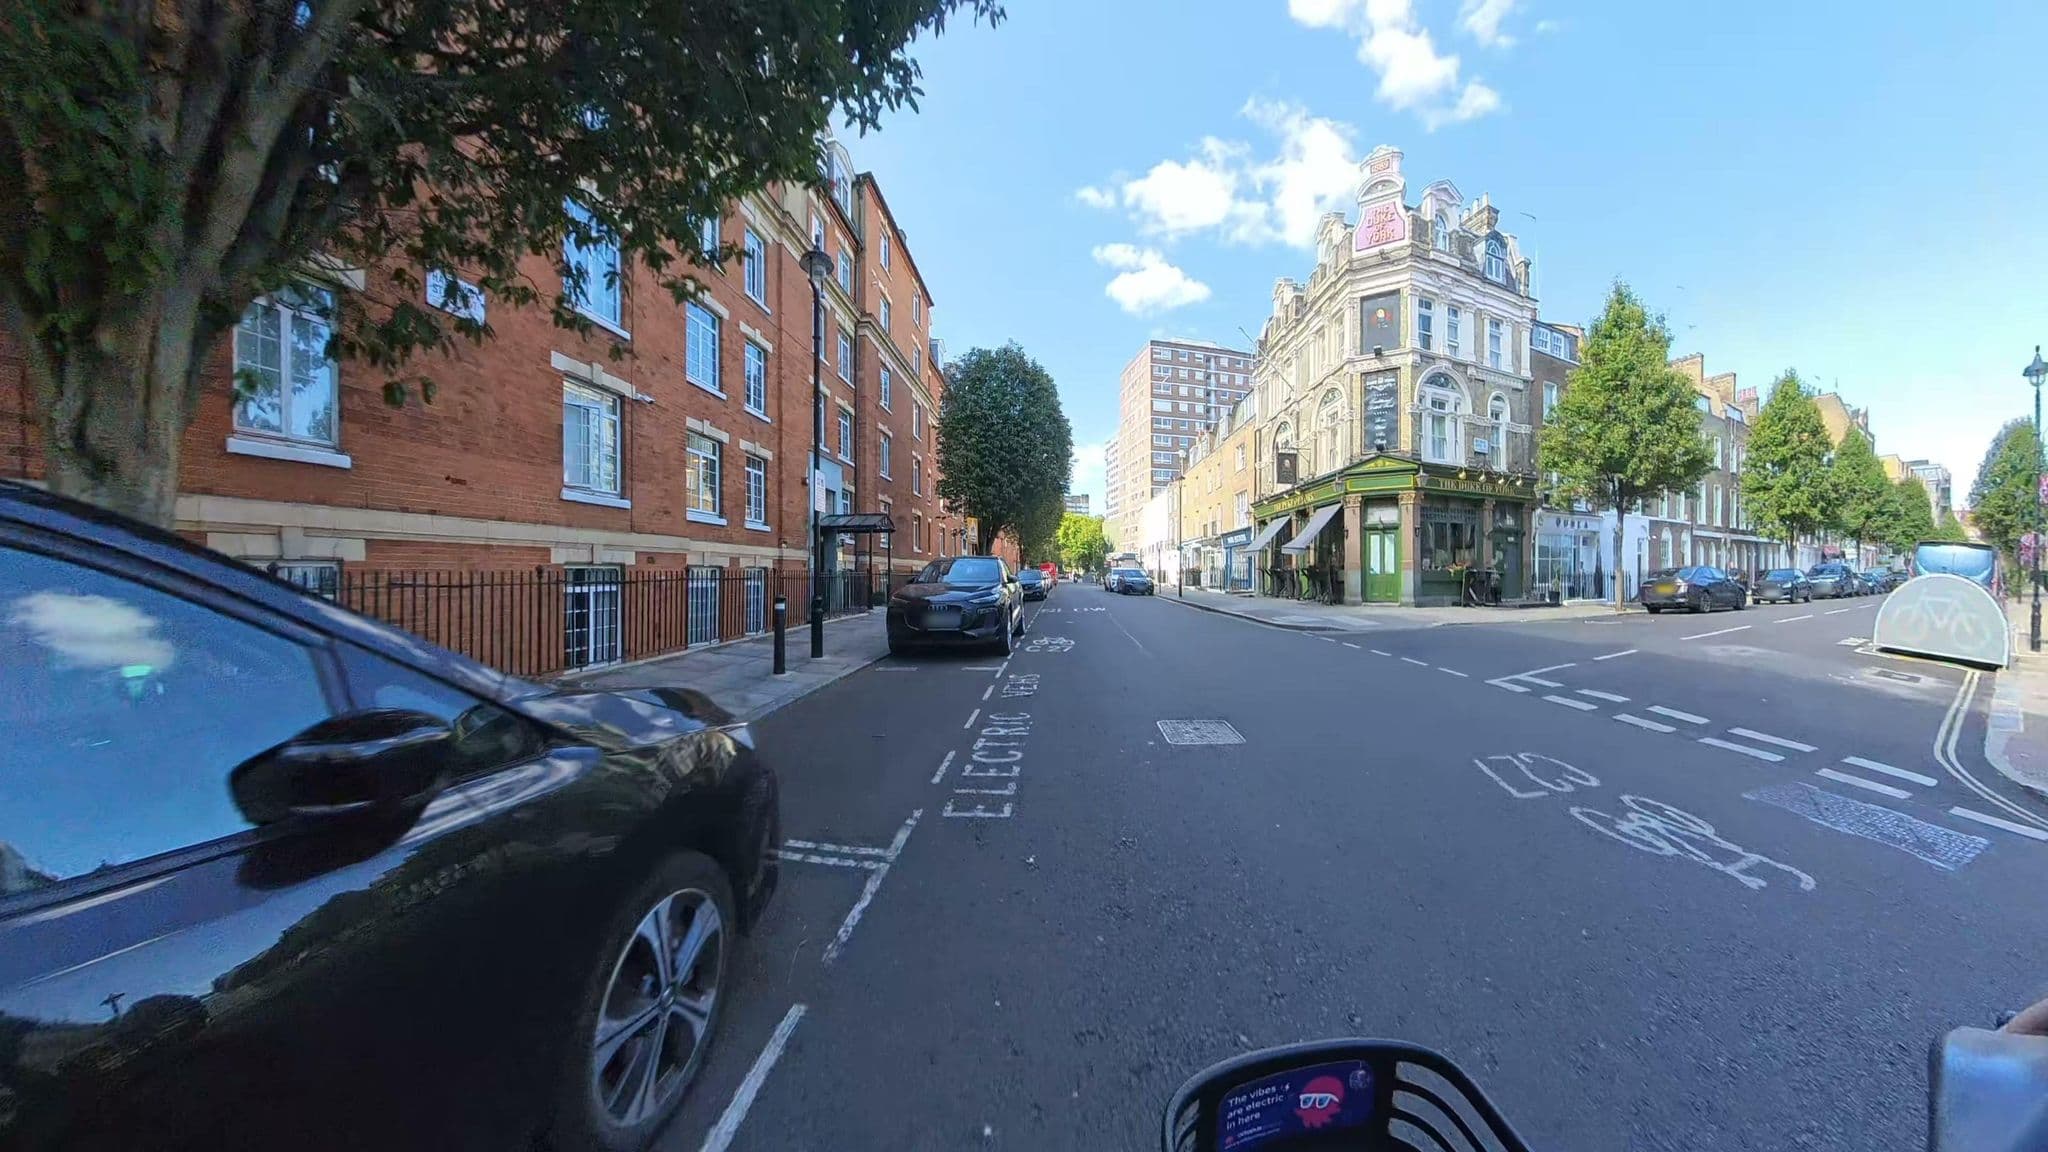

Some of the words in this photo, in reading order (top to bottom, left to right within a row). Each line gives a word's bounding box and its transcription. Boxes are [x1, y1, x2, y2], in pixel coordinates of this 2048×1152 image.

[1367, 212, 1395, 228] DUKE
[1375, 224, 1386, 232] OF
[1367, 228, 1395, 244] YORK
[1439, 478, 1456, 489] THE
[1458, 480, 1481, 492] DUKE
[942, 712, 1032, 818] ELECTRIC
[1229, 1095, 1247, 1107] The
[1250, 1086, 1276, 1098] vibes
[1227, 1107, 1243, 1119] are
[1246, 1094, 1284, 1111] electric
[1238, 1112, 1260, 1125] here
